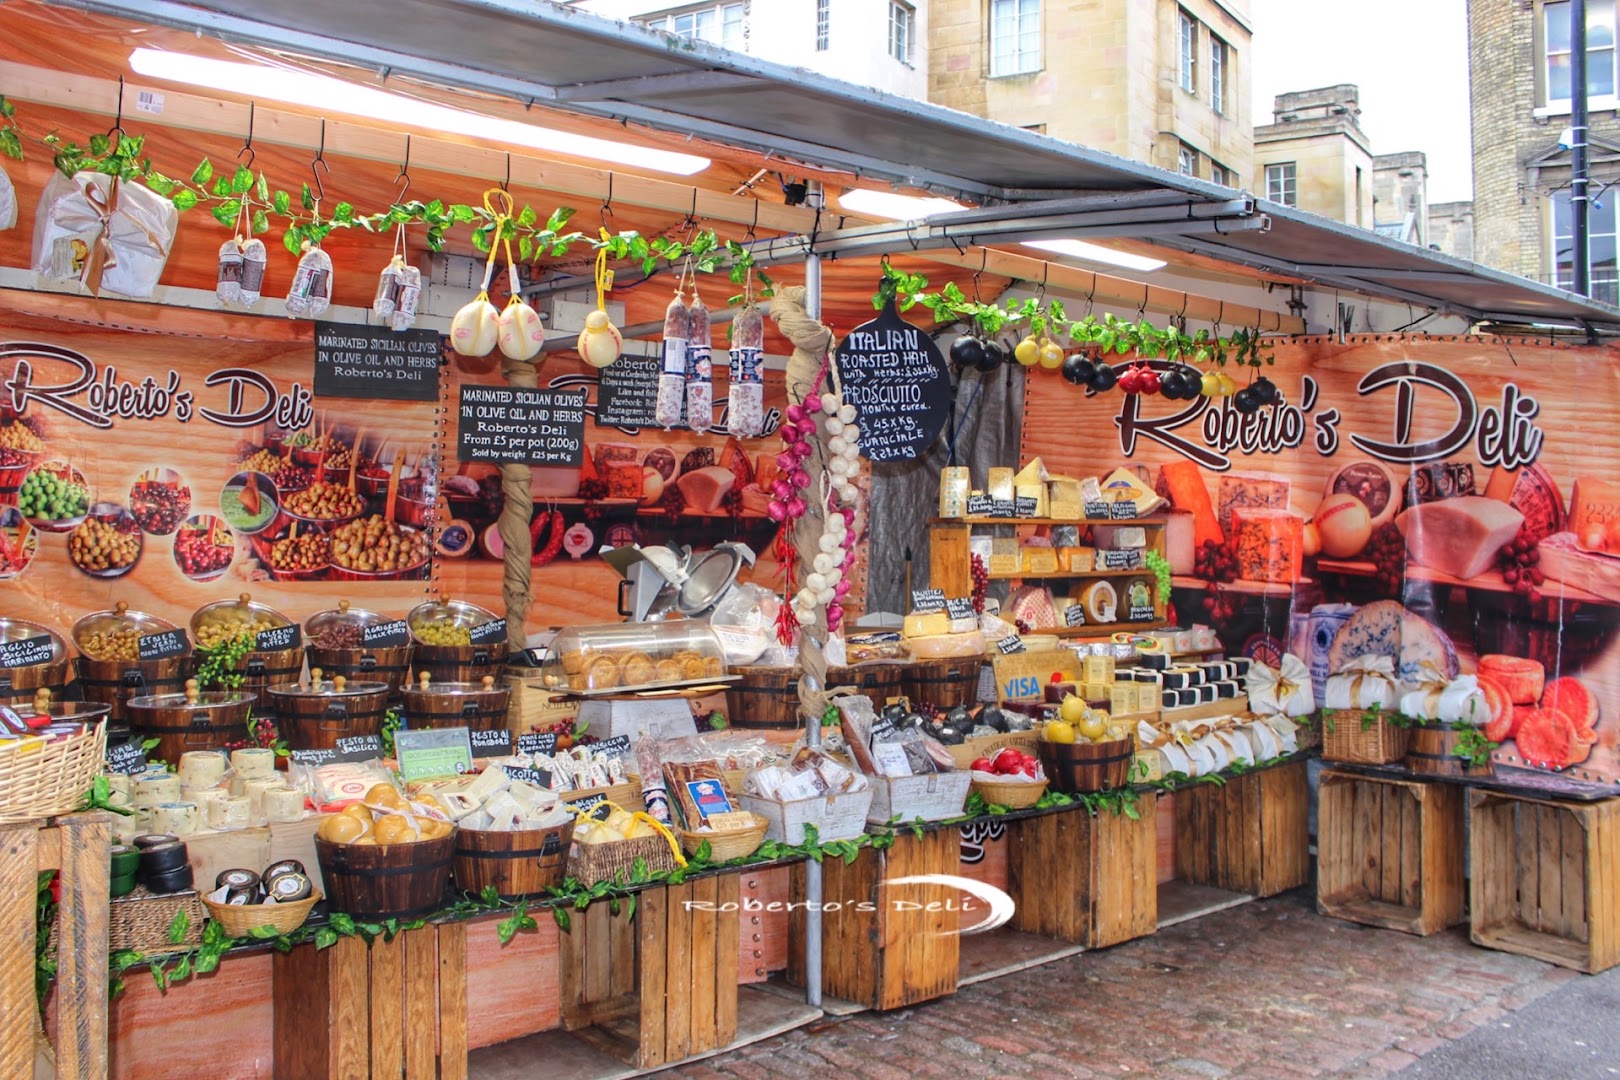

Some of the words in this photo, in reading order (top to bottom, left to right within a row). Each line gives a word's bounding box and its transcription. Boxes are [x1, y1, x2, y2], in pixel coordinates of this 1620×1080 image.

[318, 336, 368, 349] MARINATED
[370, 338, 406, 352] SICILIAN
[408, 342, 437, 354] OLIVES
[849, 329, 919, 351] ITALIAN
[318, 351, 329, 362] IN
[332, 352, 362, 364] OLIVE
[365, 353, 381, 366] OIL
[383, 355, 404, 367] AND
[407, 356, 437, 369] HERBS
[611, 357, 661, 371] oberto'
[840, 352, 899, 369] ROASTED
[903, 351, 929, 366] HAM
[334, 366, 393, 379] Roberto's
[396, 369, 422, 380] Deli
[0, 341, 193, 429] Roberto's
[200, 368, 313, 429] Deli
[617, 388, 632, 396] Like
[633, 388, 645, 396] and
[645, 388, 657, 397] foll
[462, 390, 513, 404] MARINATED
[515, 392, 551, 406] SICILIAN
[554, 394, 583, 407] OLIVES
[842, 383, 921, 405] PROSCIUTTO
[462, 405, 473, 417] IN
[476, 406, 506, 419] OLIVE
[509, 408, 527, 420] OIL
[528, 409, 549, 421] AND
[553, 410, 583, 423] HERBS
[1114, 358, 1340, 471] Roberto's
[1350, 360, 1543, 470] Deli
[477, 421, 537, 434] Roberto's
[541, 425, 567, 435] Deli
[463, 433, 491, 445] From
[493, 435, 507, 445] £5
[508, 438, 526, 449] per
[528, 438, 545, 449] pot
[546, 437, 579, 451] (200g)
[472, 448, 489, 457] Sold
[490, 449, 500, 458] by
[501, 450, 526, 459] weight
[532, 451, 546, 459] £25
[547, 452, 559, 460] per
[560, 452, 571, 462] Kg
[256, 628, 294, 640] PALERMO
[364, 620, 406, 634] AGRIGENTO
[139, 632, 176, 646] ETNEA
[0, 641, 35, 653] AGLIO
[1, 643, 53, 660] SICILIANO
[140, 649, 159, 657] NON
[160, 643, 183, 653] PITTED
[4, 652, 50, 667] MARINATO
[1003, 676, 1040, 698] VISA
[336, 736, 364, 747] PESTO
[471, 730, 499, 740] PESTO
[587, 736, 626, 751] SALSICCIA
[456, 762, 464, 773] 5
